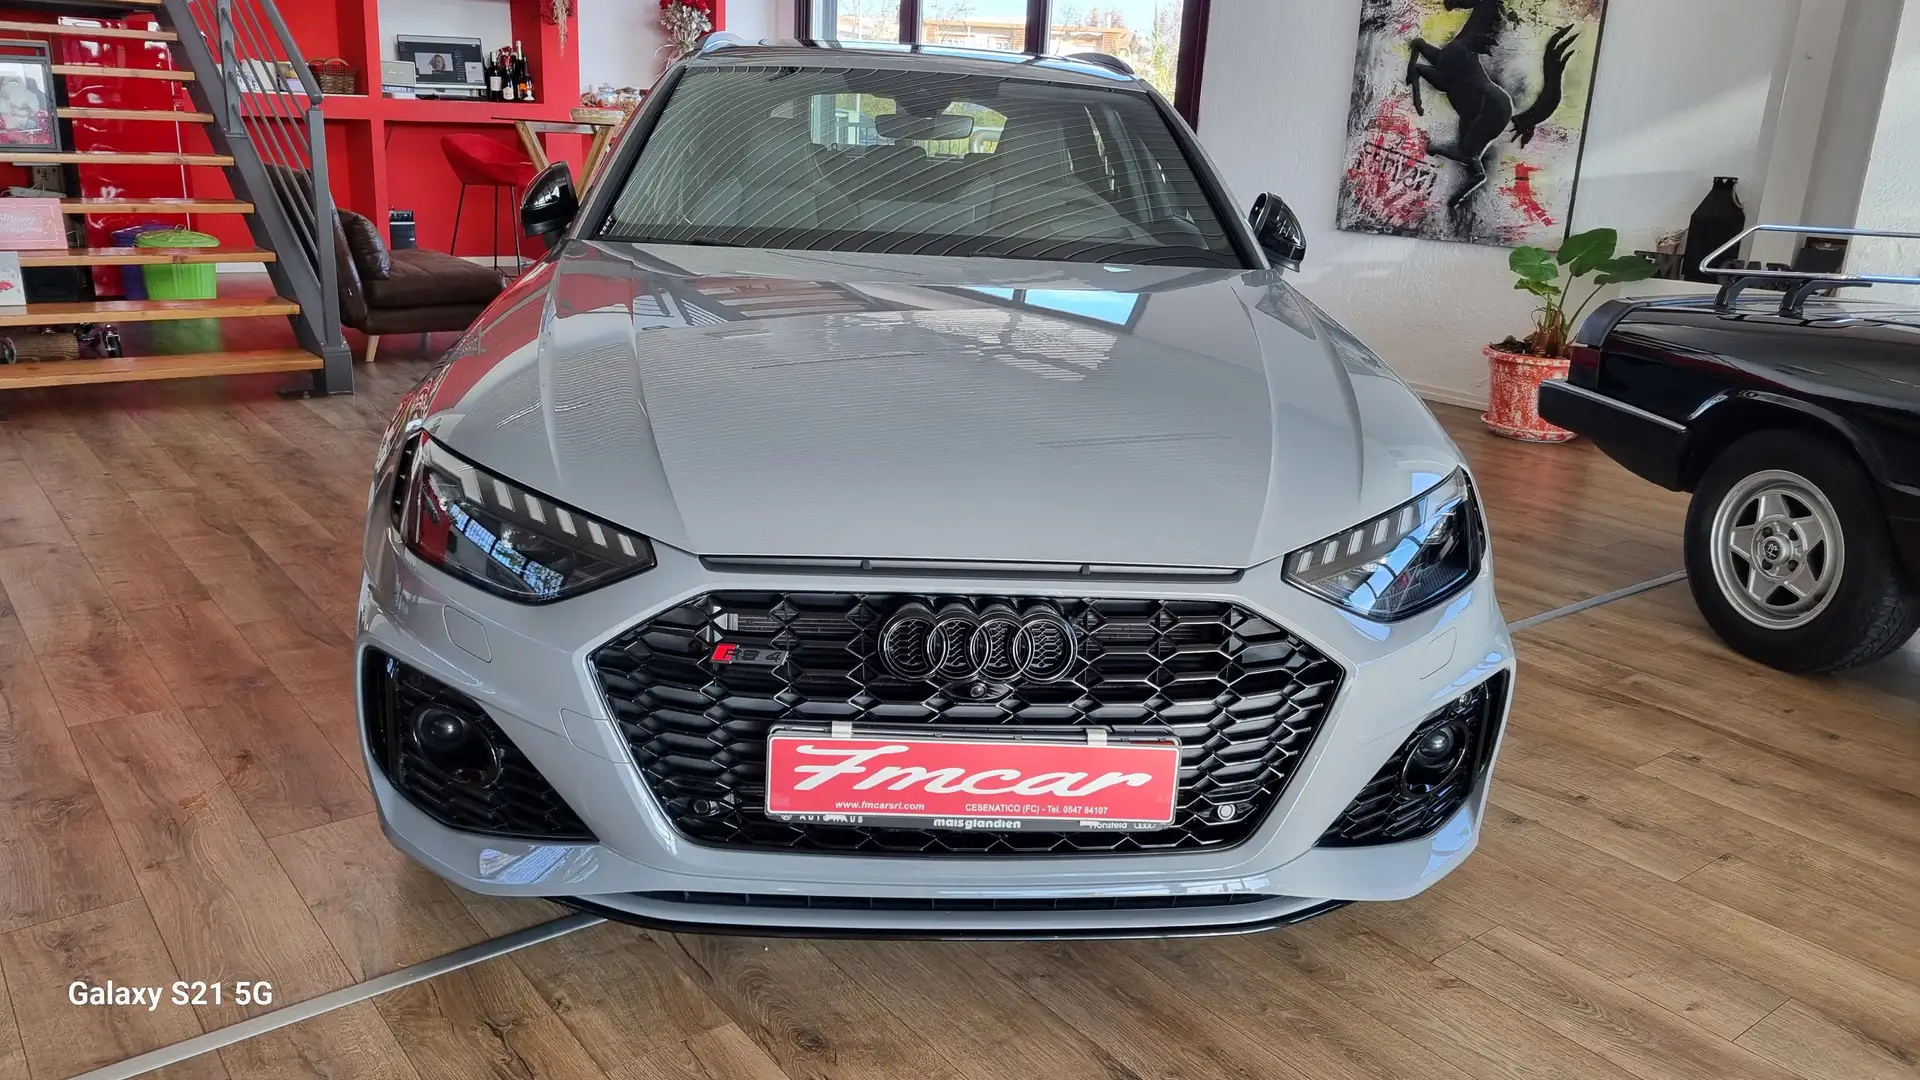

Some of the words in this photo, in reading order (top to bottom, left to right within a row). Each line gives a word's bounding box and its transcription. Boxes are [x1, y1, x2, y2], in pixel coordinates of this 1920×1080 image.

[793, 745, 1152, 796] Fmcar
[835, 800, 925, 811] www.fmcarsrl.com
[965, 803, 1020, 813] CESENATICO
[1022, 804, 1040, 815] (FC)
[1047, 805, 1061, 814] Tel.
[1063, 806, 1083, 815] 0547
[1084, 806, 1109, 816] 84107
